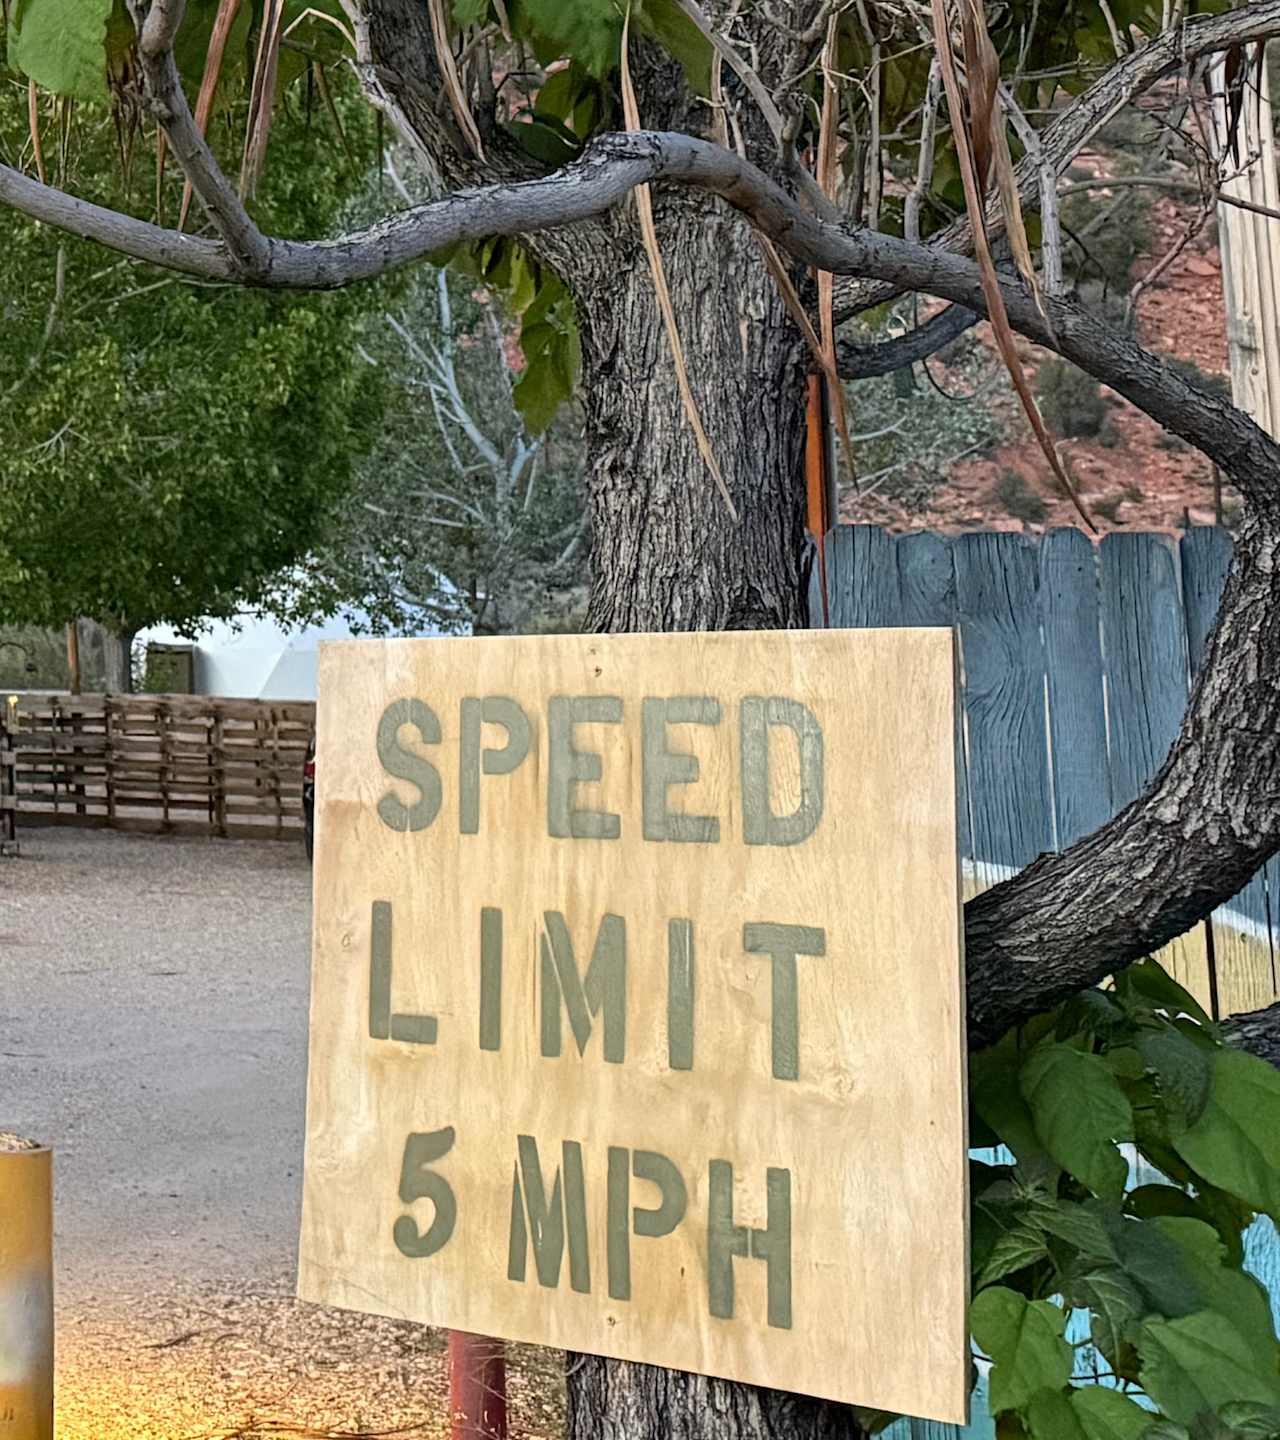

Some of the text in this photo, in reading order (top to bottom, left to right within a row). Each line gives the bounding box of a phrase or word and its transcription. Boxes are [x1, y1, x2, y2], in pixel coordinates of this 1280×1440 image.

[375, 695, 827, 847] SPEED
[368, 900, 827, 1081] LIMIT
[392, 1124, 793, 1331] 5 MPH
